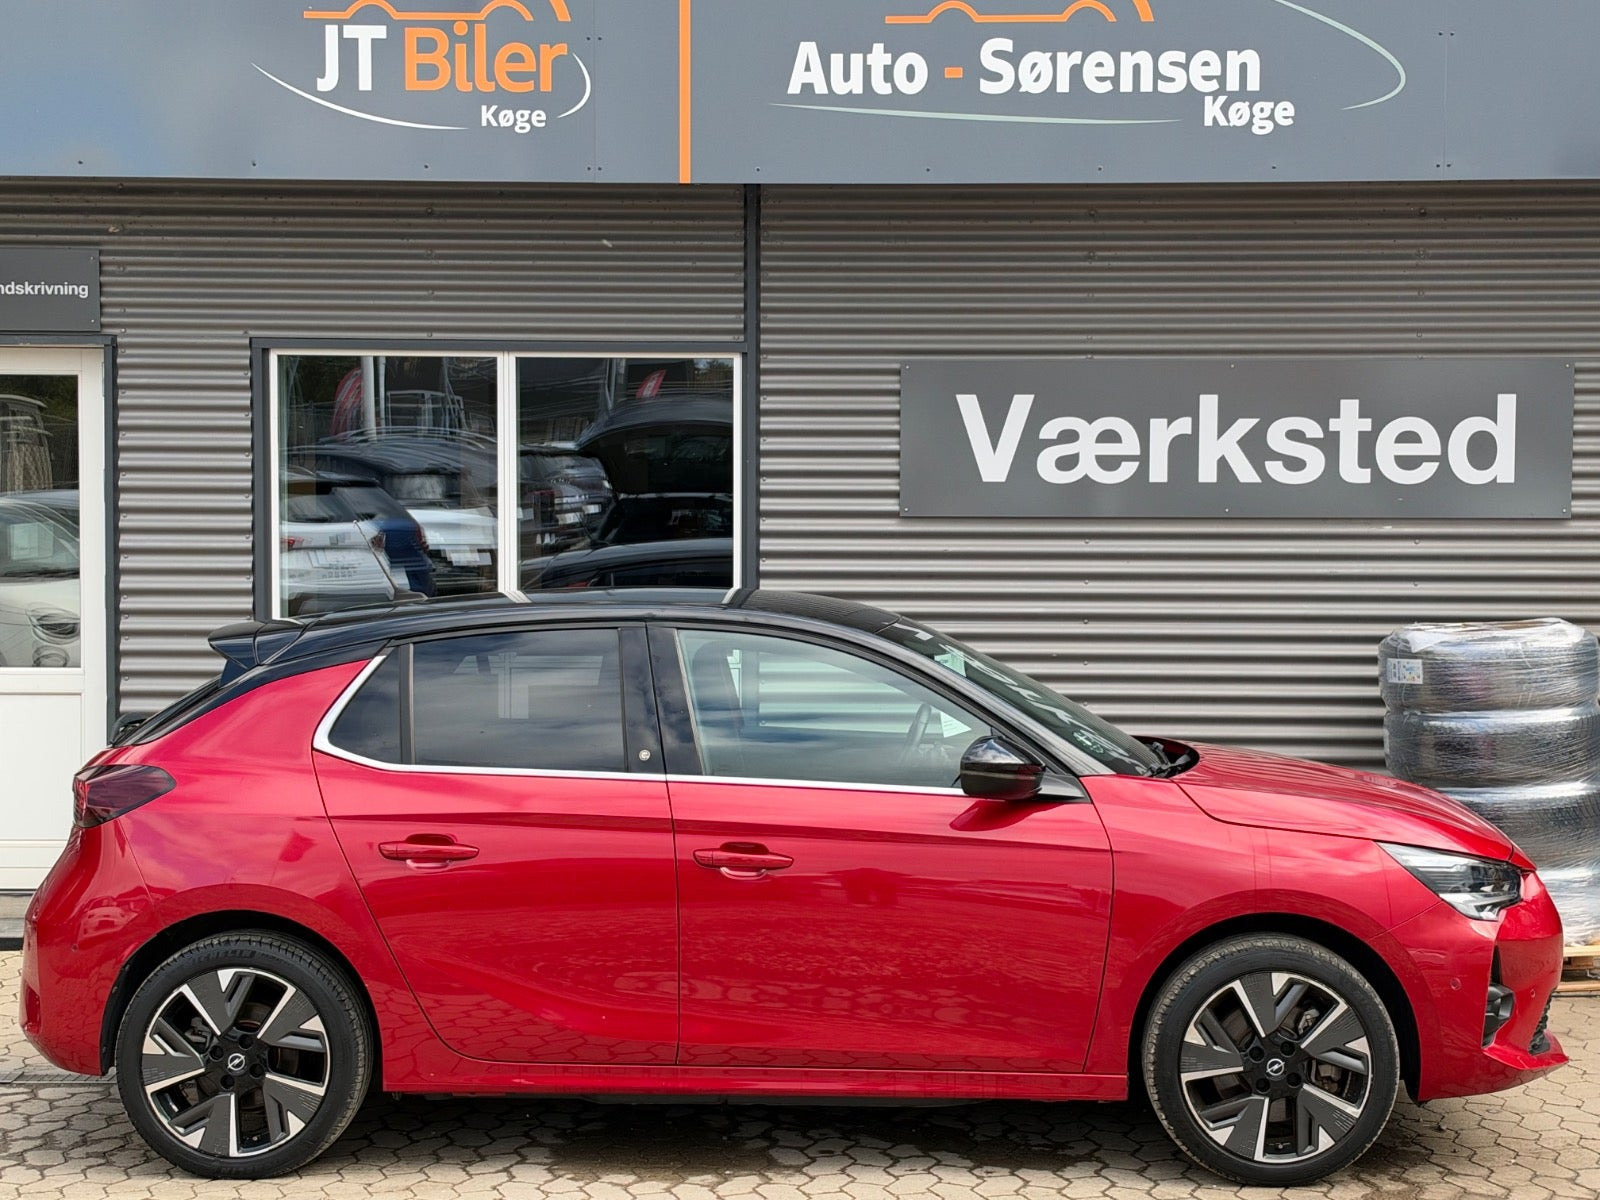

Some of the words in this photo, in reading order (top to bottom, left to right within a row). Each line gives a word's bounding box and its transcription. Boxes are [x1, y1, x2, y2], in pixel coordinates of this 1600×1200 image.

[316, 24, 388, 92] JT
[404, 21, 567, 93] Biler
[786, 41, 929, 96] Auto
[979, 37, 1261, 96] Sørensen
[480, 104, 547, 134] Køge
[1203, 95, 1295, 136] Køge
[955, 393, 1518, 486] Værksted
